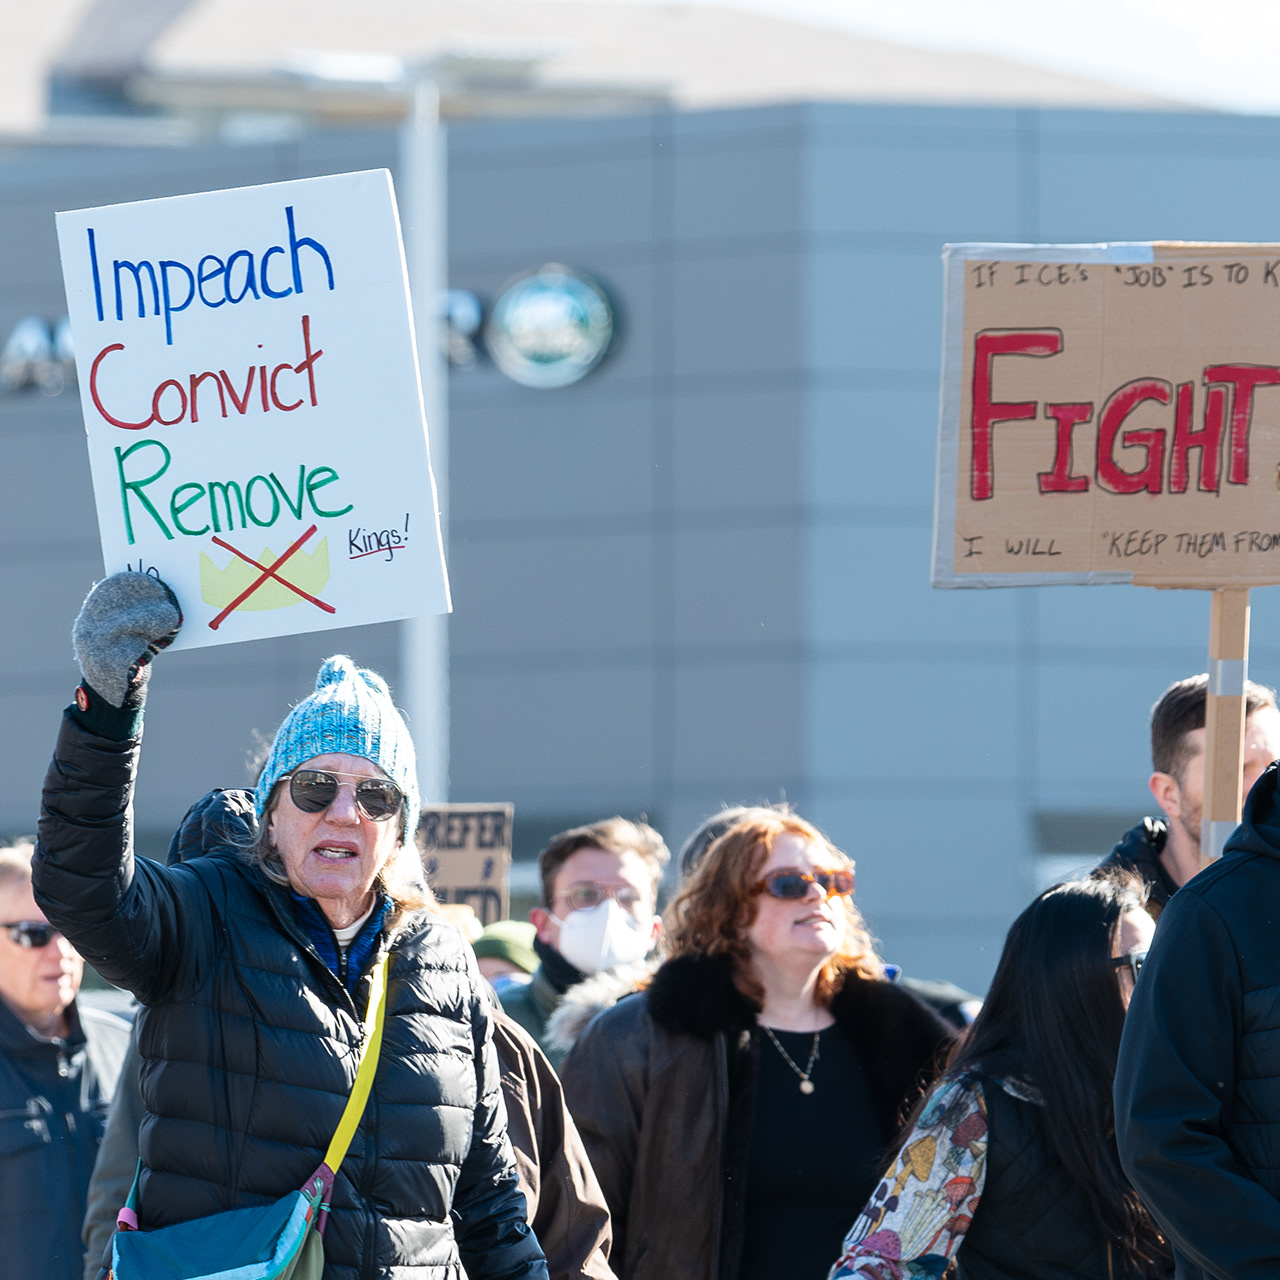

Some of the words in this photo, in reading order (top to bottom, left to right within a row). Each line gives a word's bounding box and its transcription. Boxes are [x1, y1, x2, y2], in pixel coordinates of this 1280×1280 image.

[86, 205, 335, 346] Impeach
[972, 261, 1001, 289] IF
[1182, 264, 1214, 289] IS
[1223, 262, 1250, 285] TO
[89, 314, 324, 431] Convict
[113, 438, 354, 546] Remove
[348, 512, 410, 562] Kings!
[963, 535, 985, 559] I
[1004, 537, 1063, 557] WILL
[1174, 531, 1227, 559] THEM
